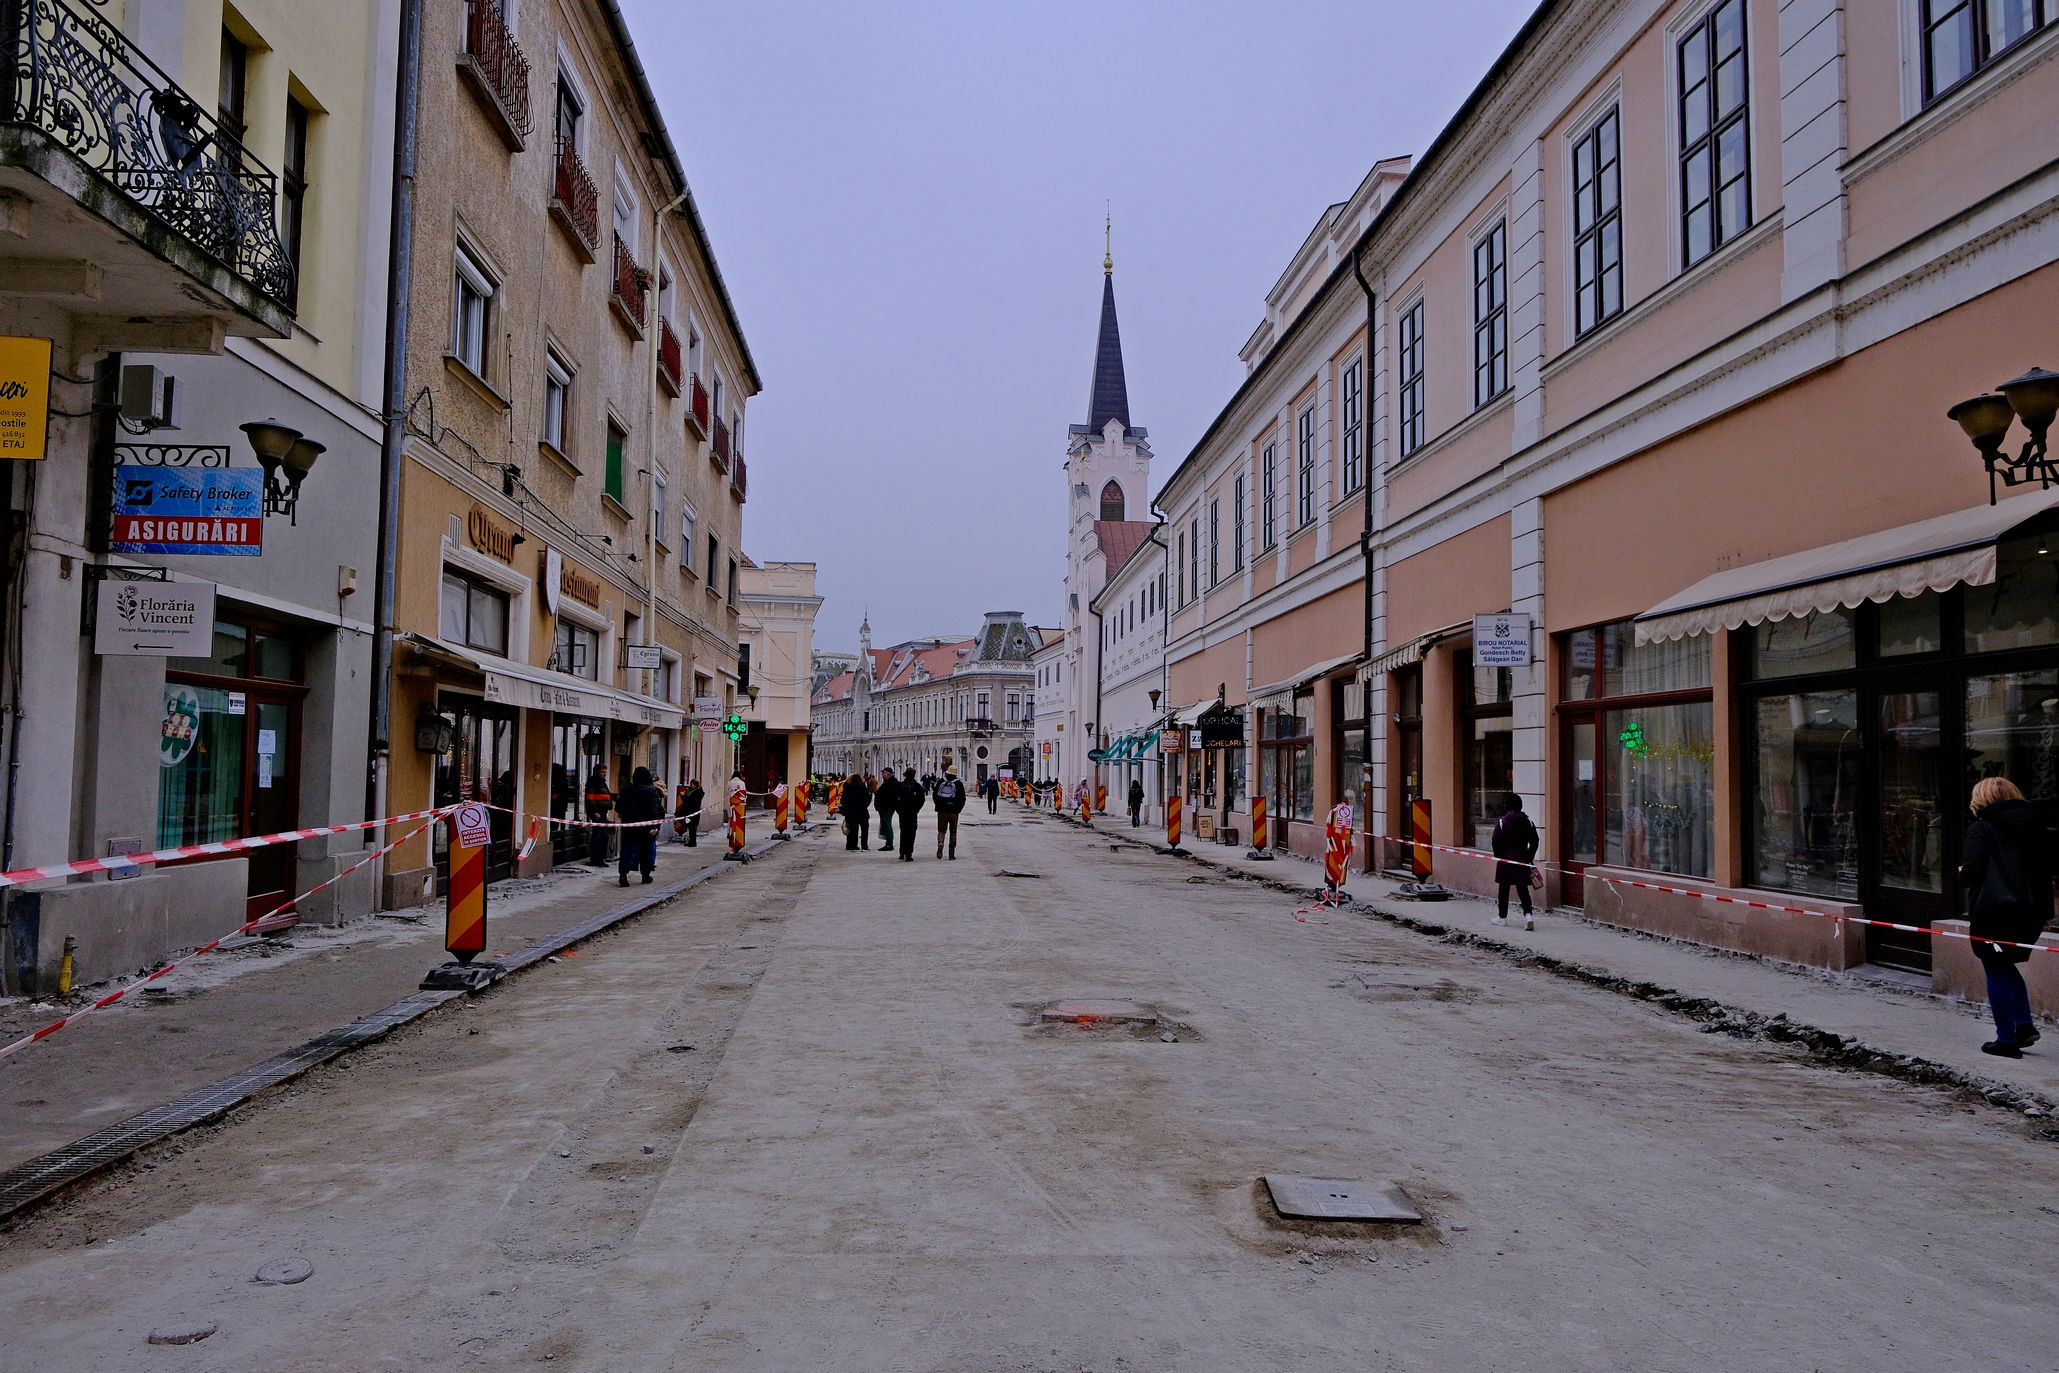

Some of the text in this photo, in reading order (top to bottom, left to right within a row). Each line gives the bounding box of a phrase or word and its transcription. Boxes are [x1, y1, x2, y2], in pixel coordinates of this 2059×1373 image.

[0, 419, 26, 428] ostile
[2, 440, 25, 448] ETAJ
[160, 486, 252, 503] Safety Broker
[128, 519, 247, 542] ASIGURĂRI
[140, 598, 195, 611] Florăria
[140, 612, 194, 624] Vincent
[724, 723, 746, 732] 14:45
